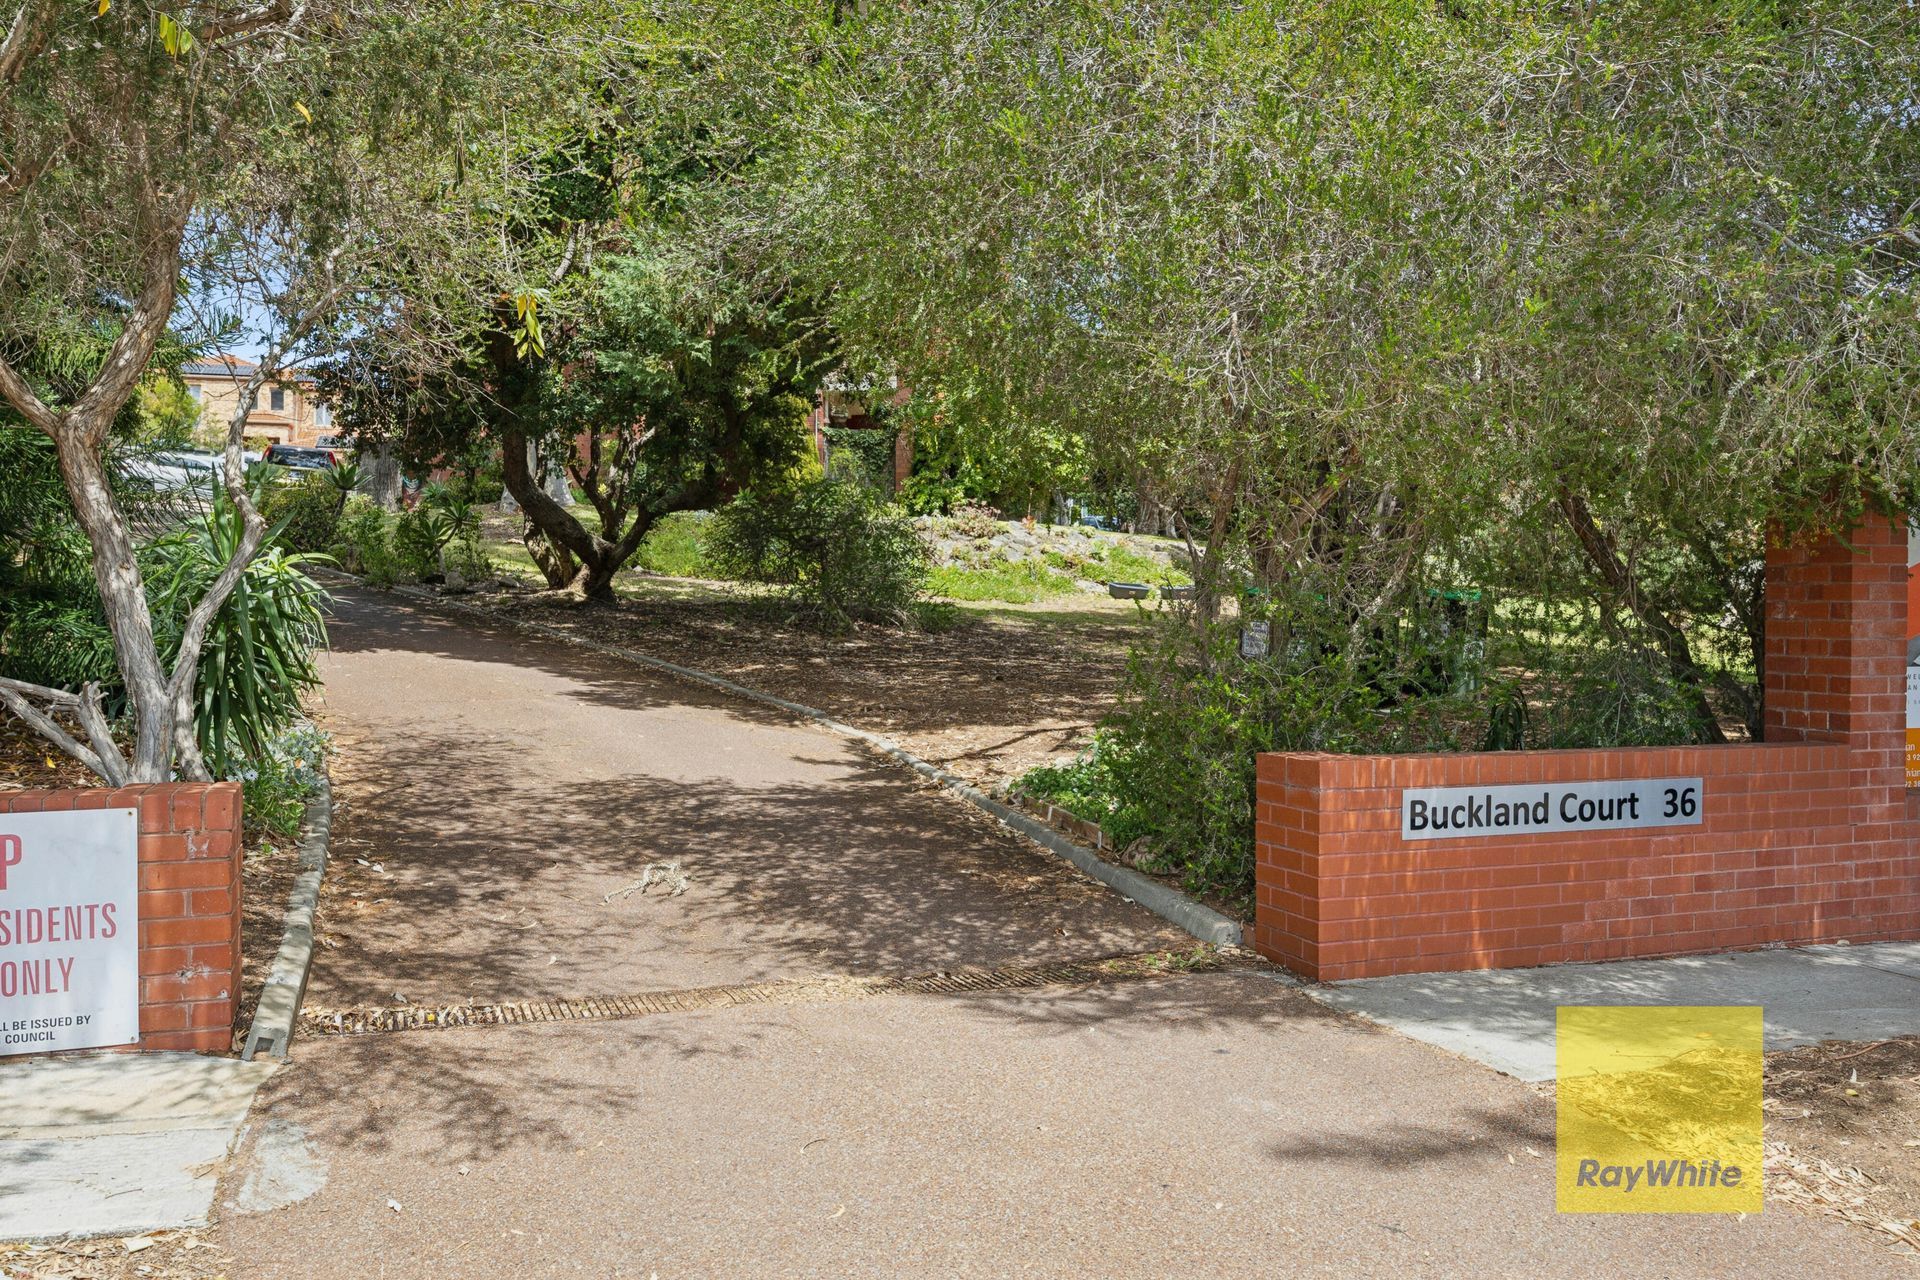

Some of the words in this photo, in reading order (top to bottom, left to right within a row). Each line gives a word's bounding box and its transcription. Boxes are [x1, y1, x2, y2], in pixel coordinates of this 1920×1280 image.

[1409, 792, 1550, 831] Buckland
[1559, 791, 1640, 824] Court
[1662, 787, 1697, 818] 36
[1, 957, 74, 998] ONLY
[12, 1020, 27, 1031] BE
[30, 1016, 73, 1029] ISSUED
[76, 1014, 92, 1025] BY
[5, 1031, 56, 1044] COUNCIL
